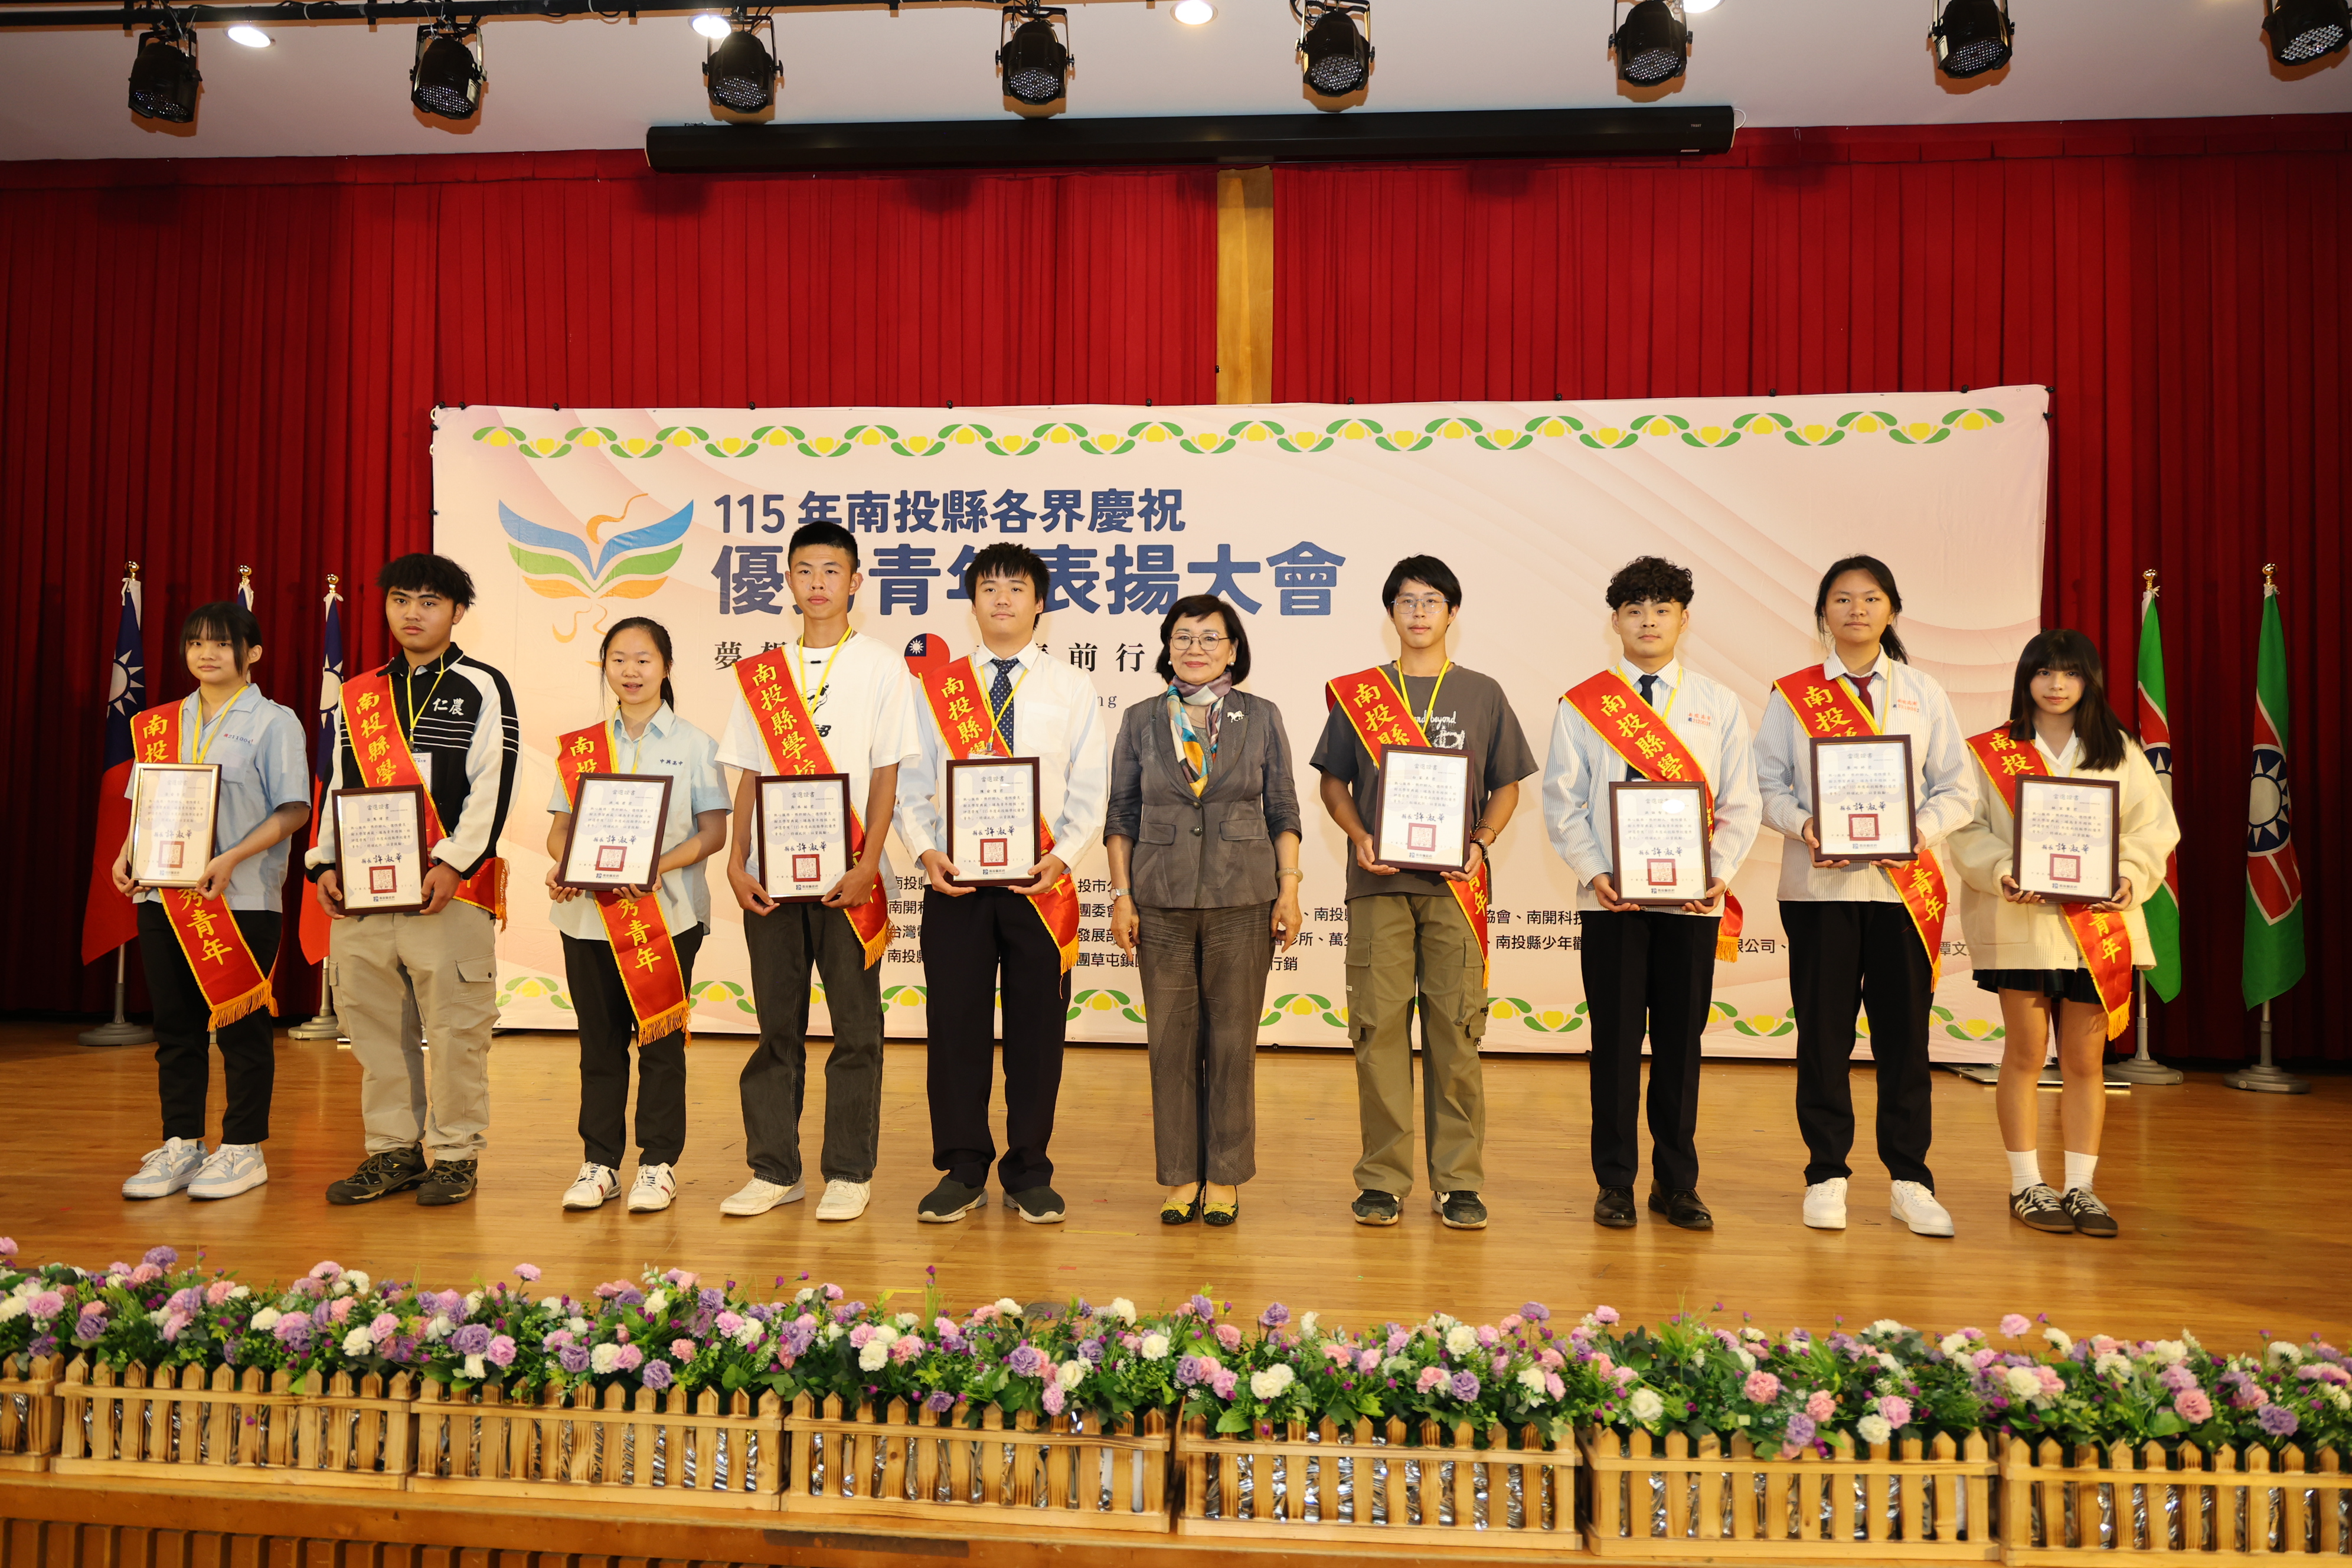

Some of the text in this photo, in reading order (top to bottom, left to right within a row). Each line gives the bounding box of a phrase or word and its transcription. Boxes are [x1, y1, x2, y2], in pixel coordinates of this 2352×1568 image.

[714, 488, 1186, 534] 115 年南投縣各界慶祝
[710, 540, 1347, 616] 優青表揚大會
[432, 697, 465, 716] 仁農
[1353, 682, 1410, 746] 南投縣
[1429, 710, 1457, 730] beyond
[142, 714, 169, 763] 南投
[355, 691, 397, 786] 南投縣學
[1600, 694, 1684, 779] 南投縣學
[659, 758, 684, 766] 中興高中
[784, 841, 827, 853] 縣長許淑華
[972, 825, 1015, 837] 縣長許淑華
[1903, 861, 1945, 923] 青年
[1304, 907, 1348, 922] 、南投
[2088, 912, 2122, 964] 青年
[1076, 952, 1139, 967] 團草屯鎮
[1270, 956, 1298, 971] 行銷
